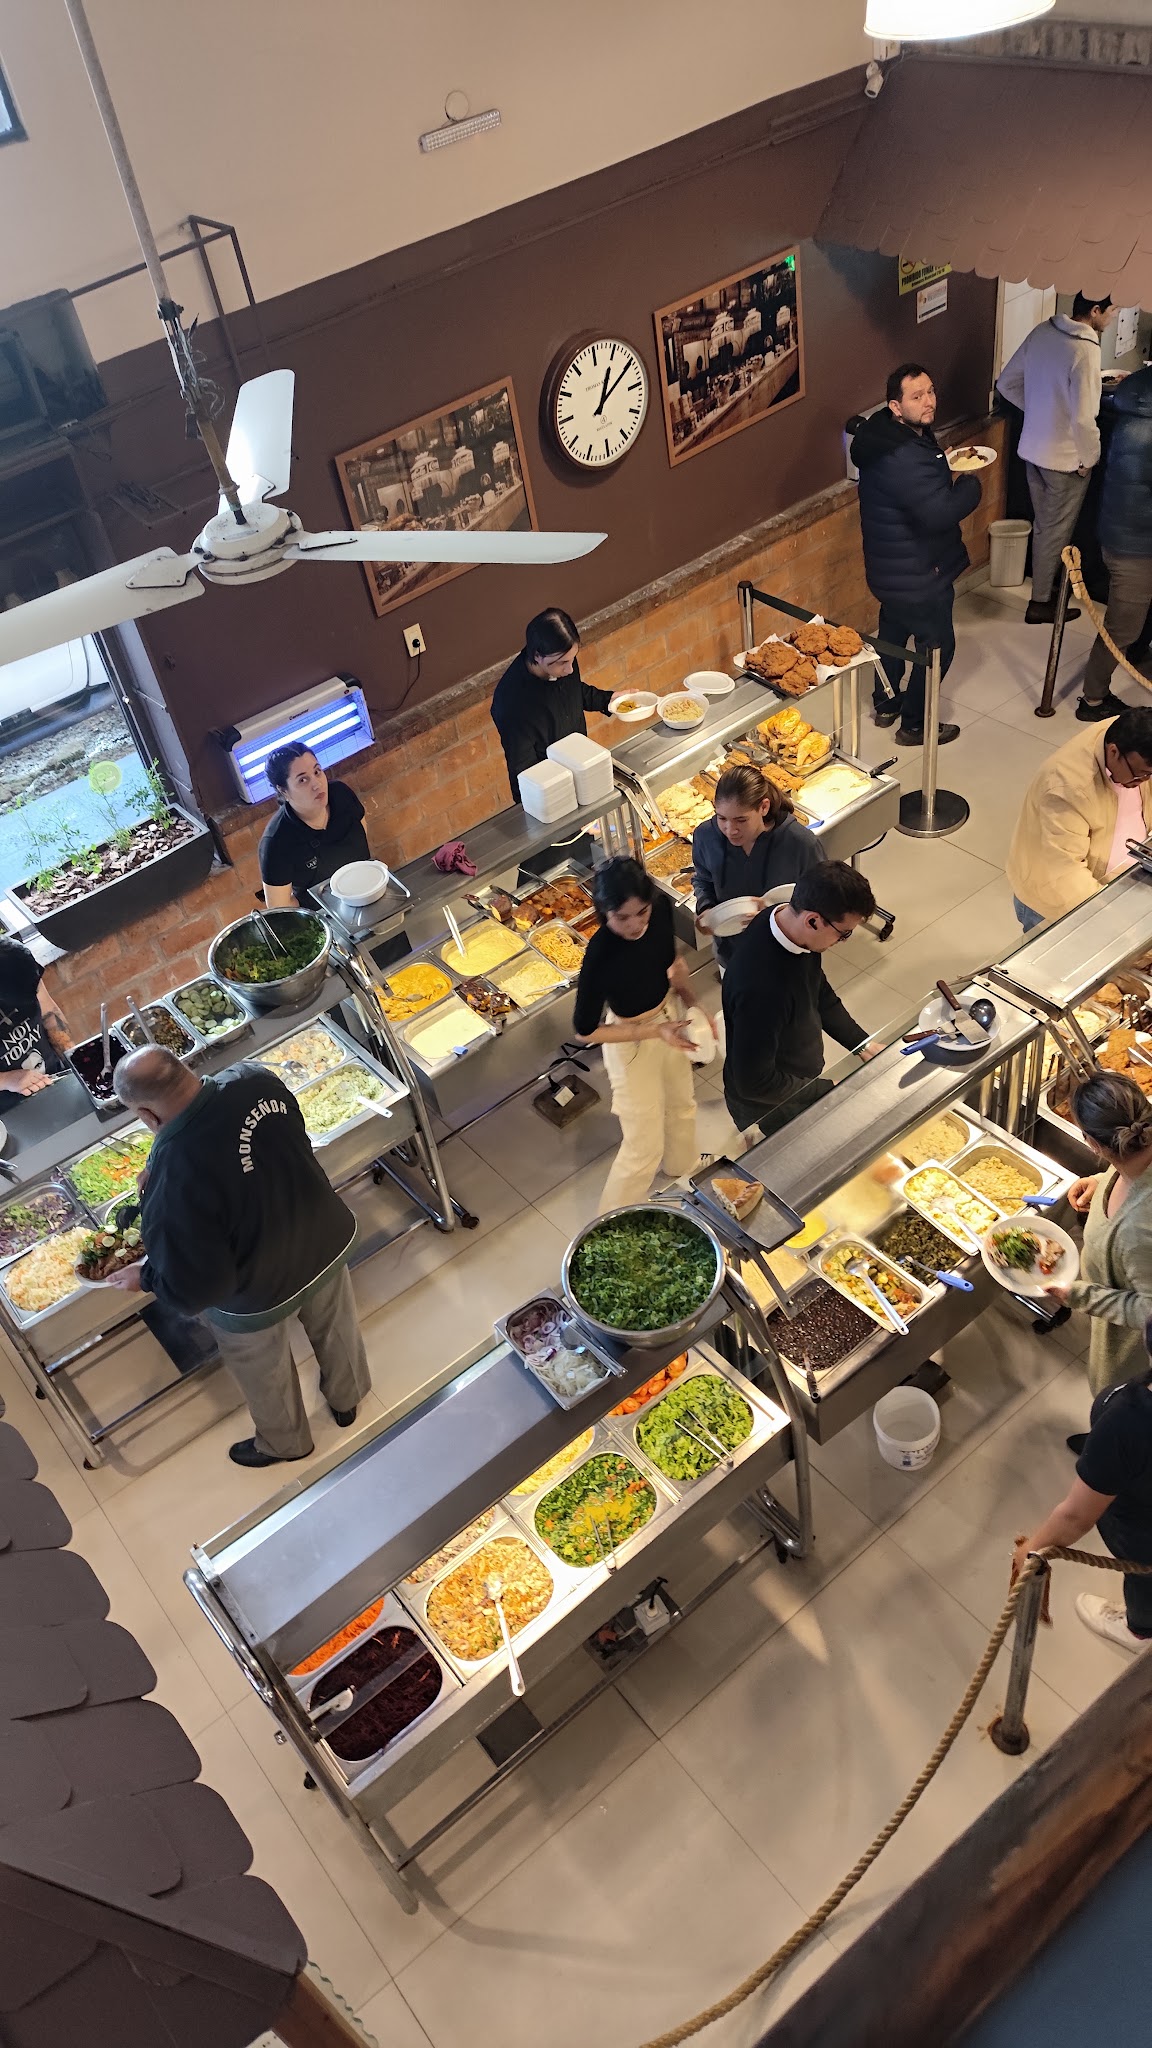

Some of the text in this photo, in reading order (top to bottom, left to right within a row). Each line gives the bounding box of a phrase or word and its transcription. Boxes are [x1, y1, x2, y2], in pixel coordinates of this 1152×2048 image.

[0, 1023, 42, 1066] TODAY
[2, 1017, 31, 1051] NOT
[239, 1098, 288, 1173] MONSEÑOR
